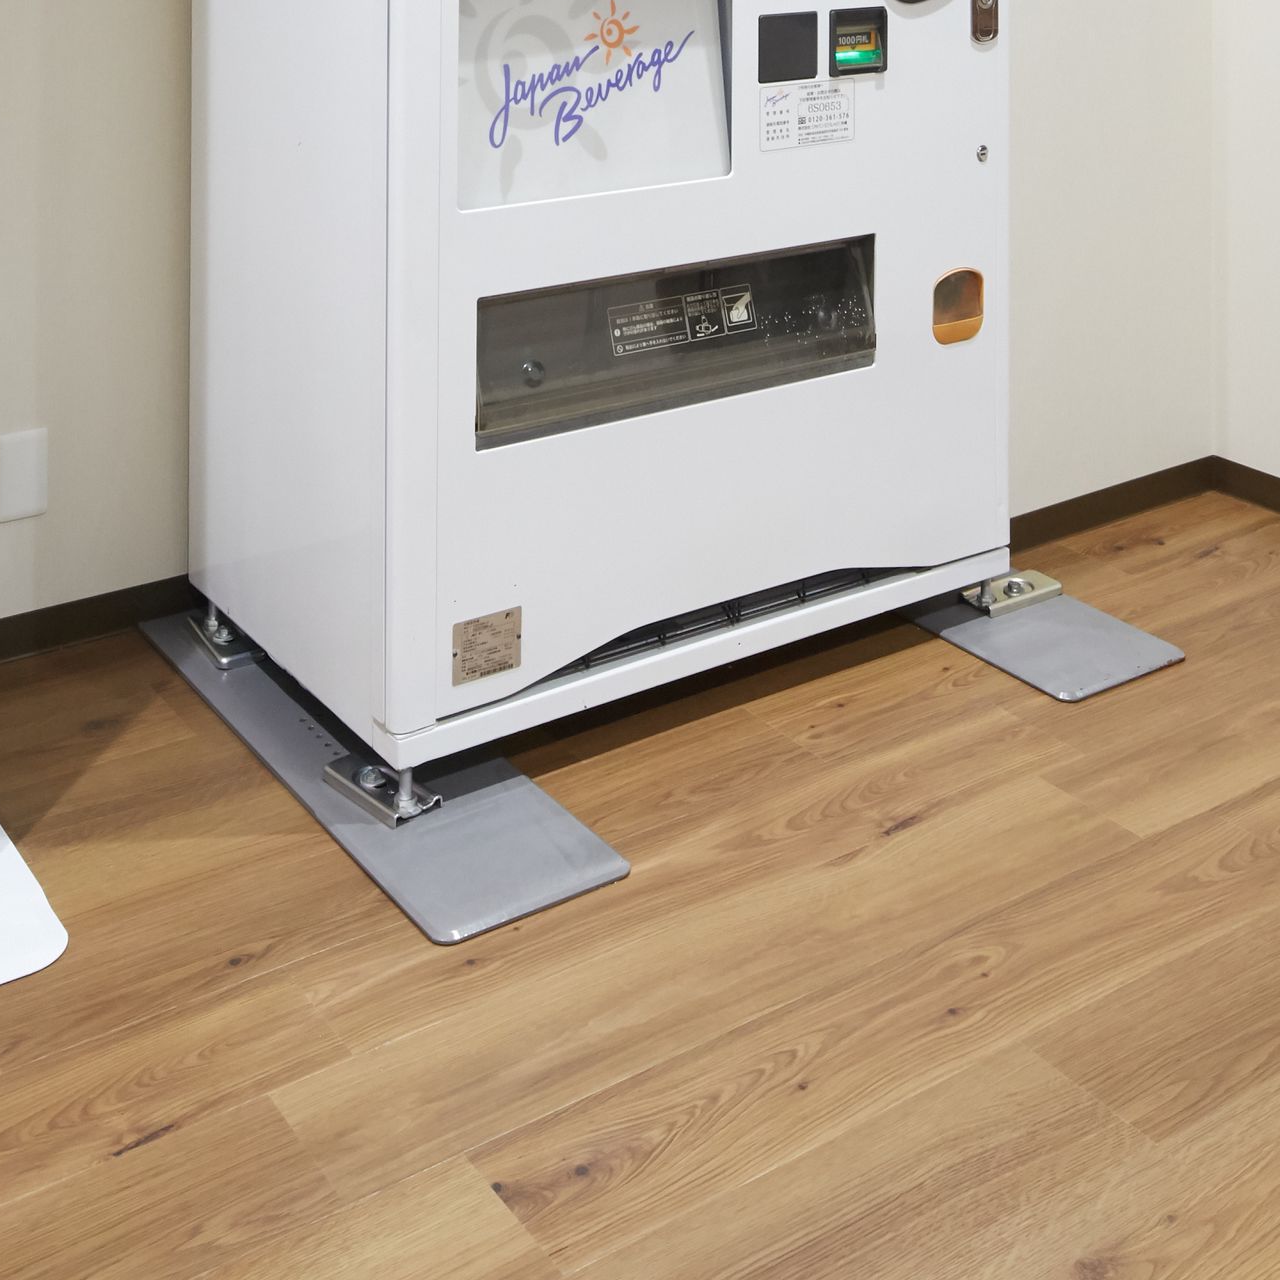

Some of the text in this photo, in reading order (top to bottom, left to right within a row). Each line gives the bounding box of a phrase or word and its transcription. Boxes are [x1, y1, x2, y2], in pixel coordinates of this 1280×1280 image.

[539, 30, 695, 146] Beverage
[838, 35, 869, 45] 1000円札
[489, 45, 600, 148] Japan
